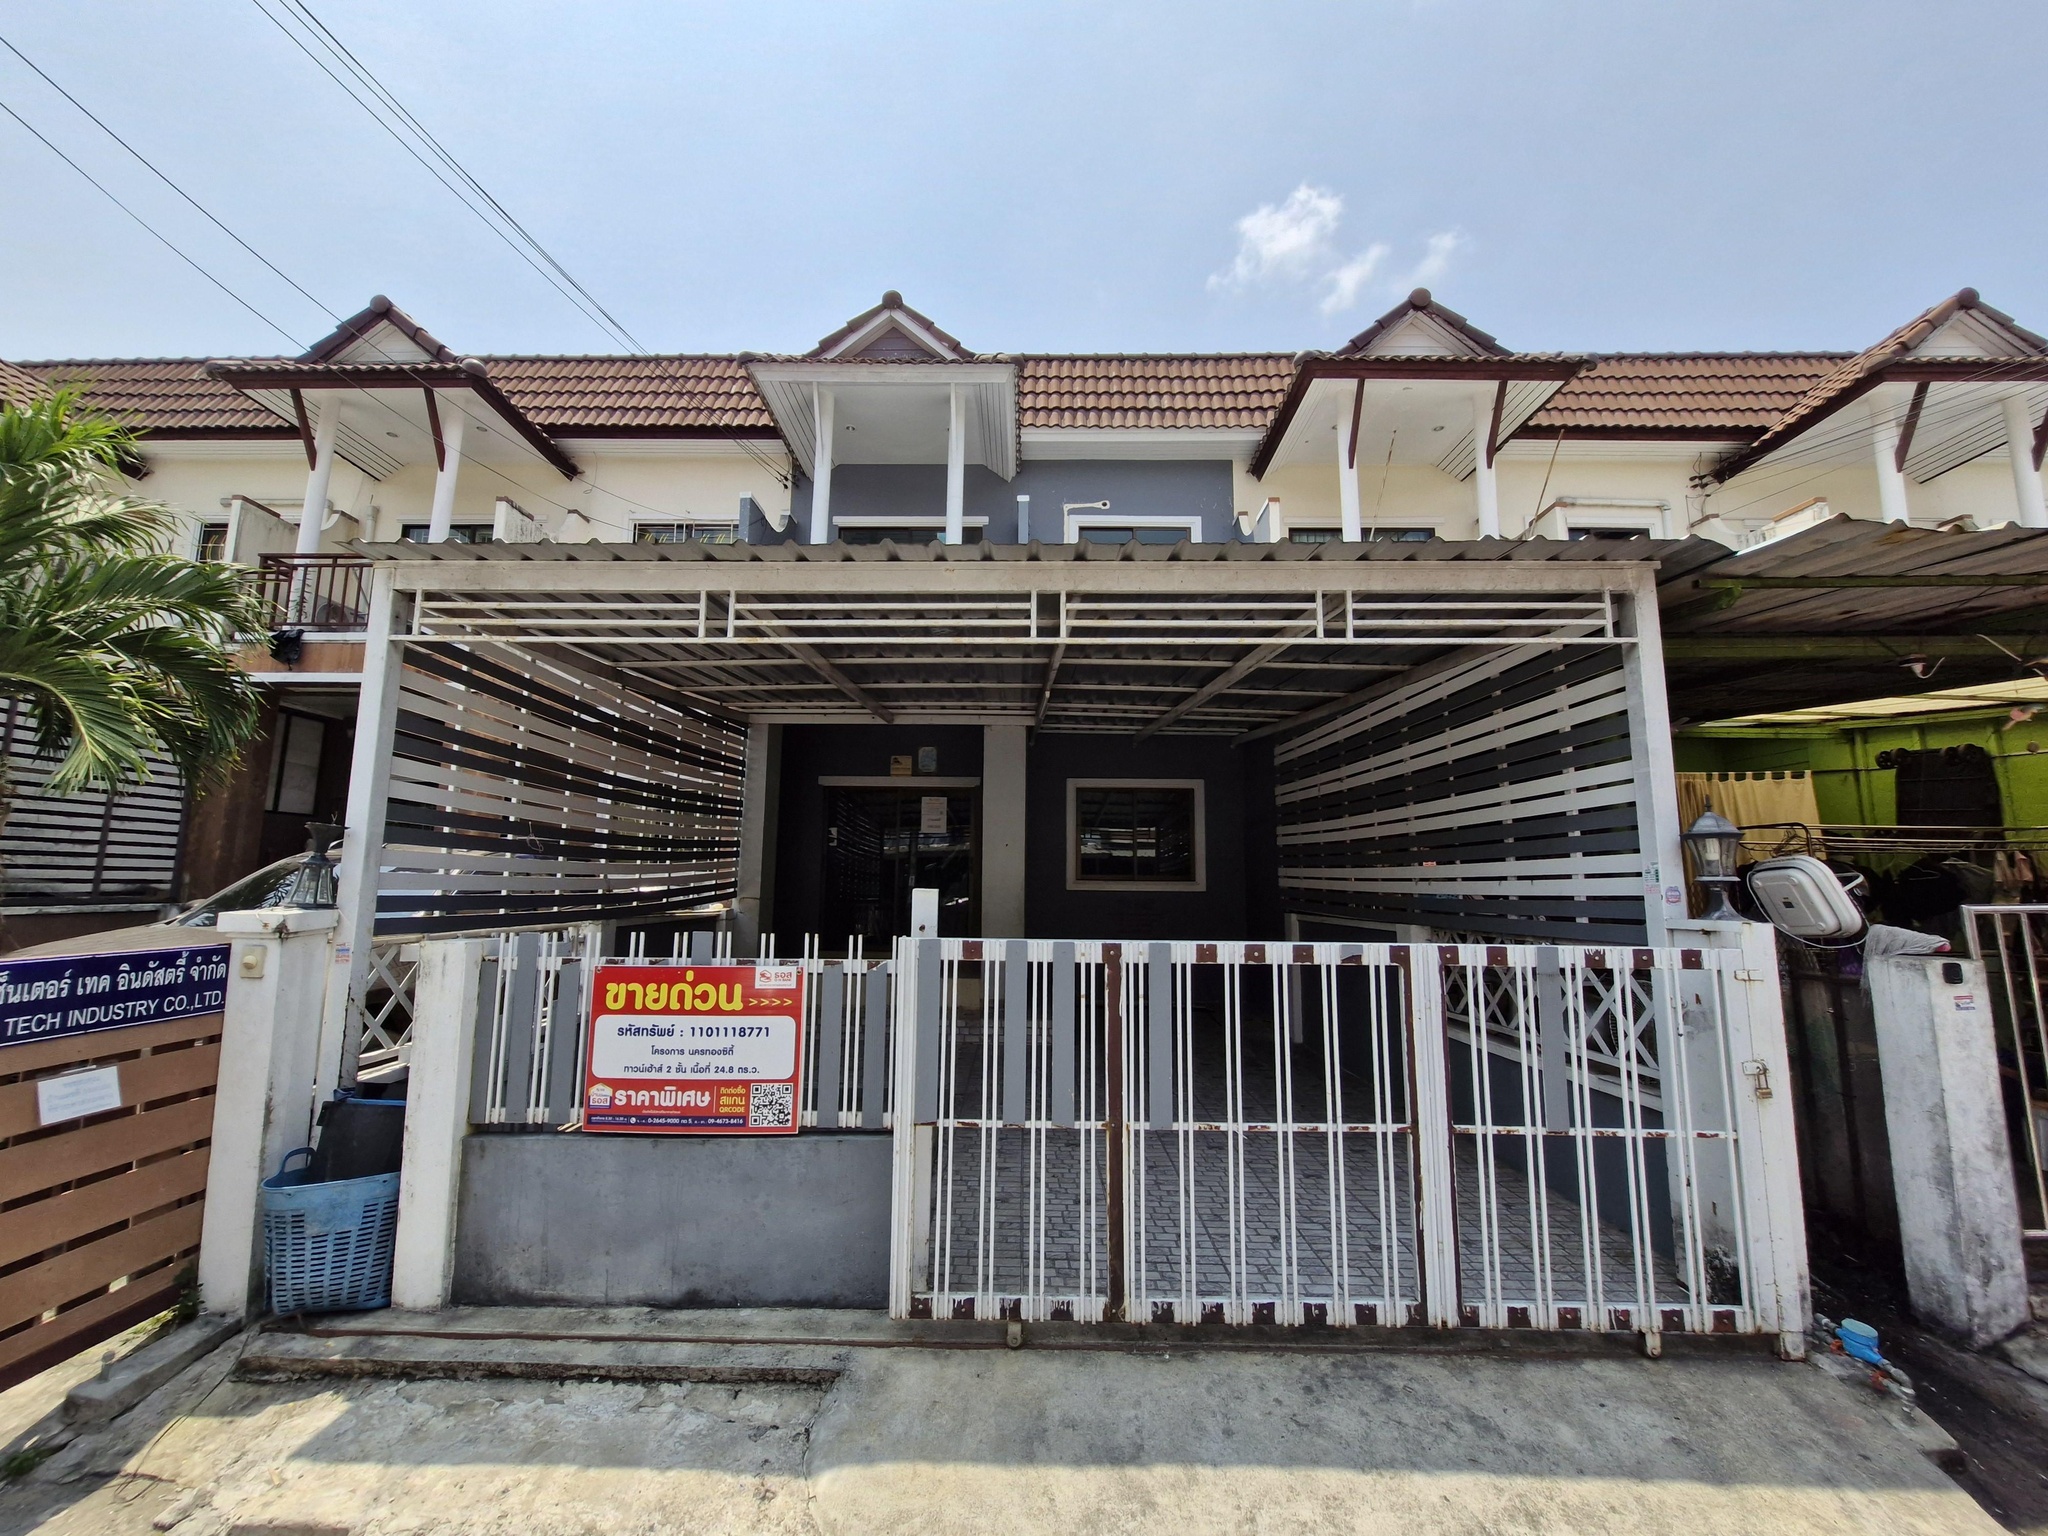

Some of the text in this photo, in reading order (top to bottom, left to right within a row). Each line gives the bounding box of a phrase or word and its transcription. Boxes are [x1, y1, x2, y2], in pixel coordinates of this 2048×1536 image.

[76, 974, 110, 996] เทค
[117, 951, 190, 991] อินดัสตรี้
[190, 955, 226, 982] จำกัด
[774, 971, 792, 979] ธอส
[605, 969, 744, 1011] ขายด่วน
[4, 990, 224, 1036] TECH INDUSTRY CO.,LTD.
[617, 1023, 675, 1037] รหัสทรัพย์
[690, 1026, 770, 1038] 1101118771
[651, 1045, 735, 1056] โครงการ นครทองซิตี้
[623, 1064, 663, 1074] ทาวน์เฮ้าส์
[675, 1062, 687, 1074] ชั้น
[690, 1062, 711, 1074] เนื้อที่
[714, 1066, 734, 1074] 24.8
[737, 1066, 760, 1074] ตร.ว.
[720, 1084, 746, 1094] ติดต่อซื้อ
[614, 1085, 711, 1107] ราคาพิเศษ
[719, 1096, 745, 1105] สแกน
